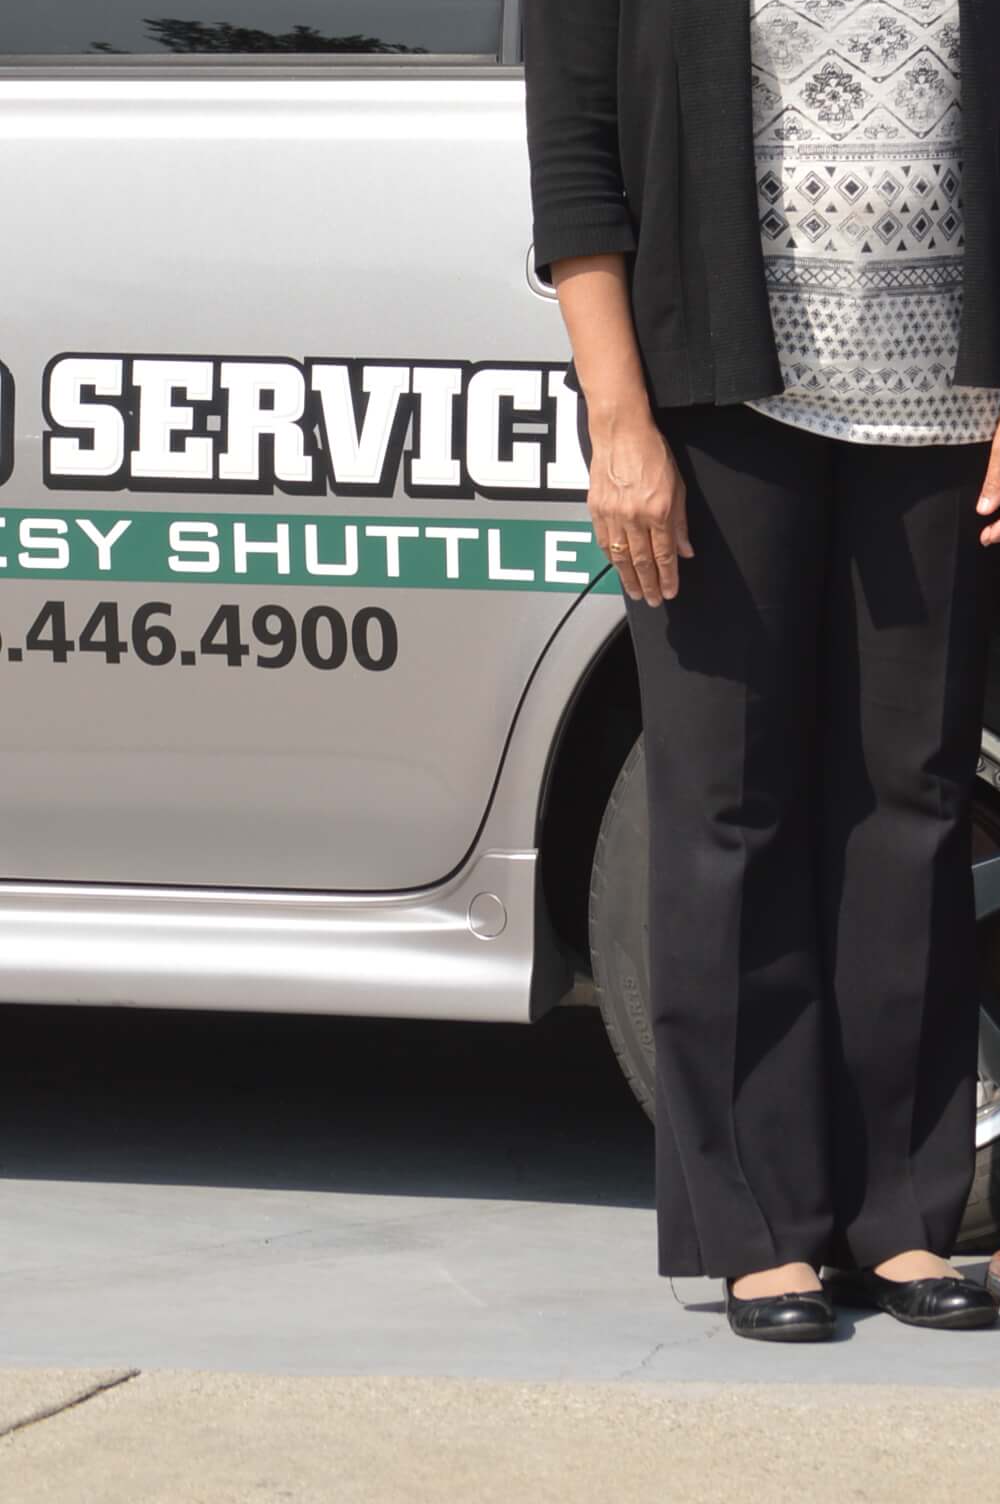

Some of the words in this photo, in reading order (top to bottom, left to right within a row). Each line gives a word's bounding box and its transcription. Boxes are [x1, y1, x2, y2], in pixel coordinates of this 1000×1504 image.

[0, 517, 133, 571] SY
[167, 520, 594, 585] SHUTTLE
[0, 600, 400, 673] .446.4900
